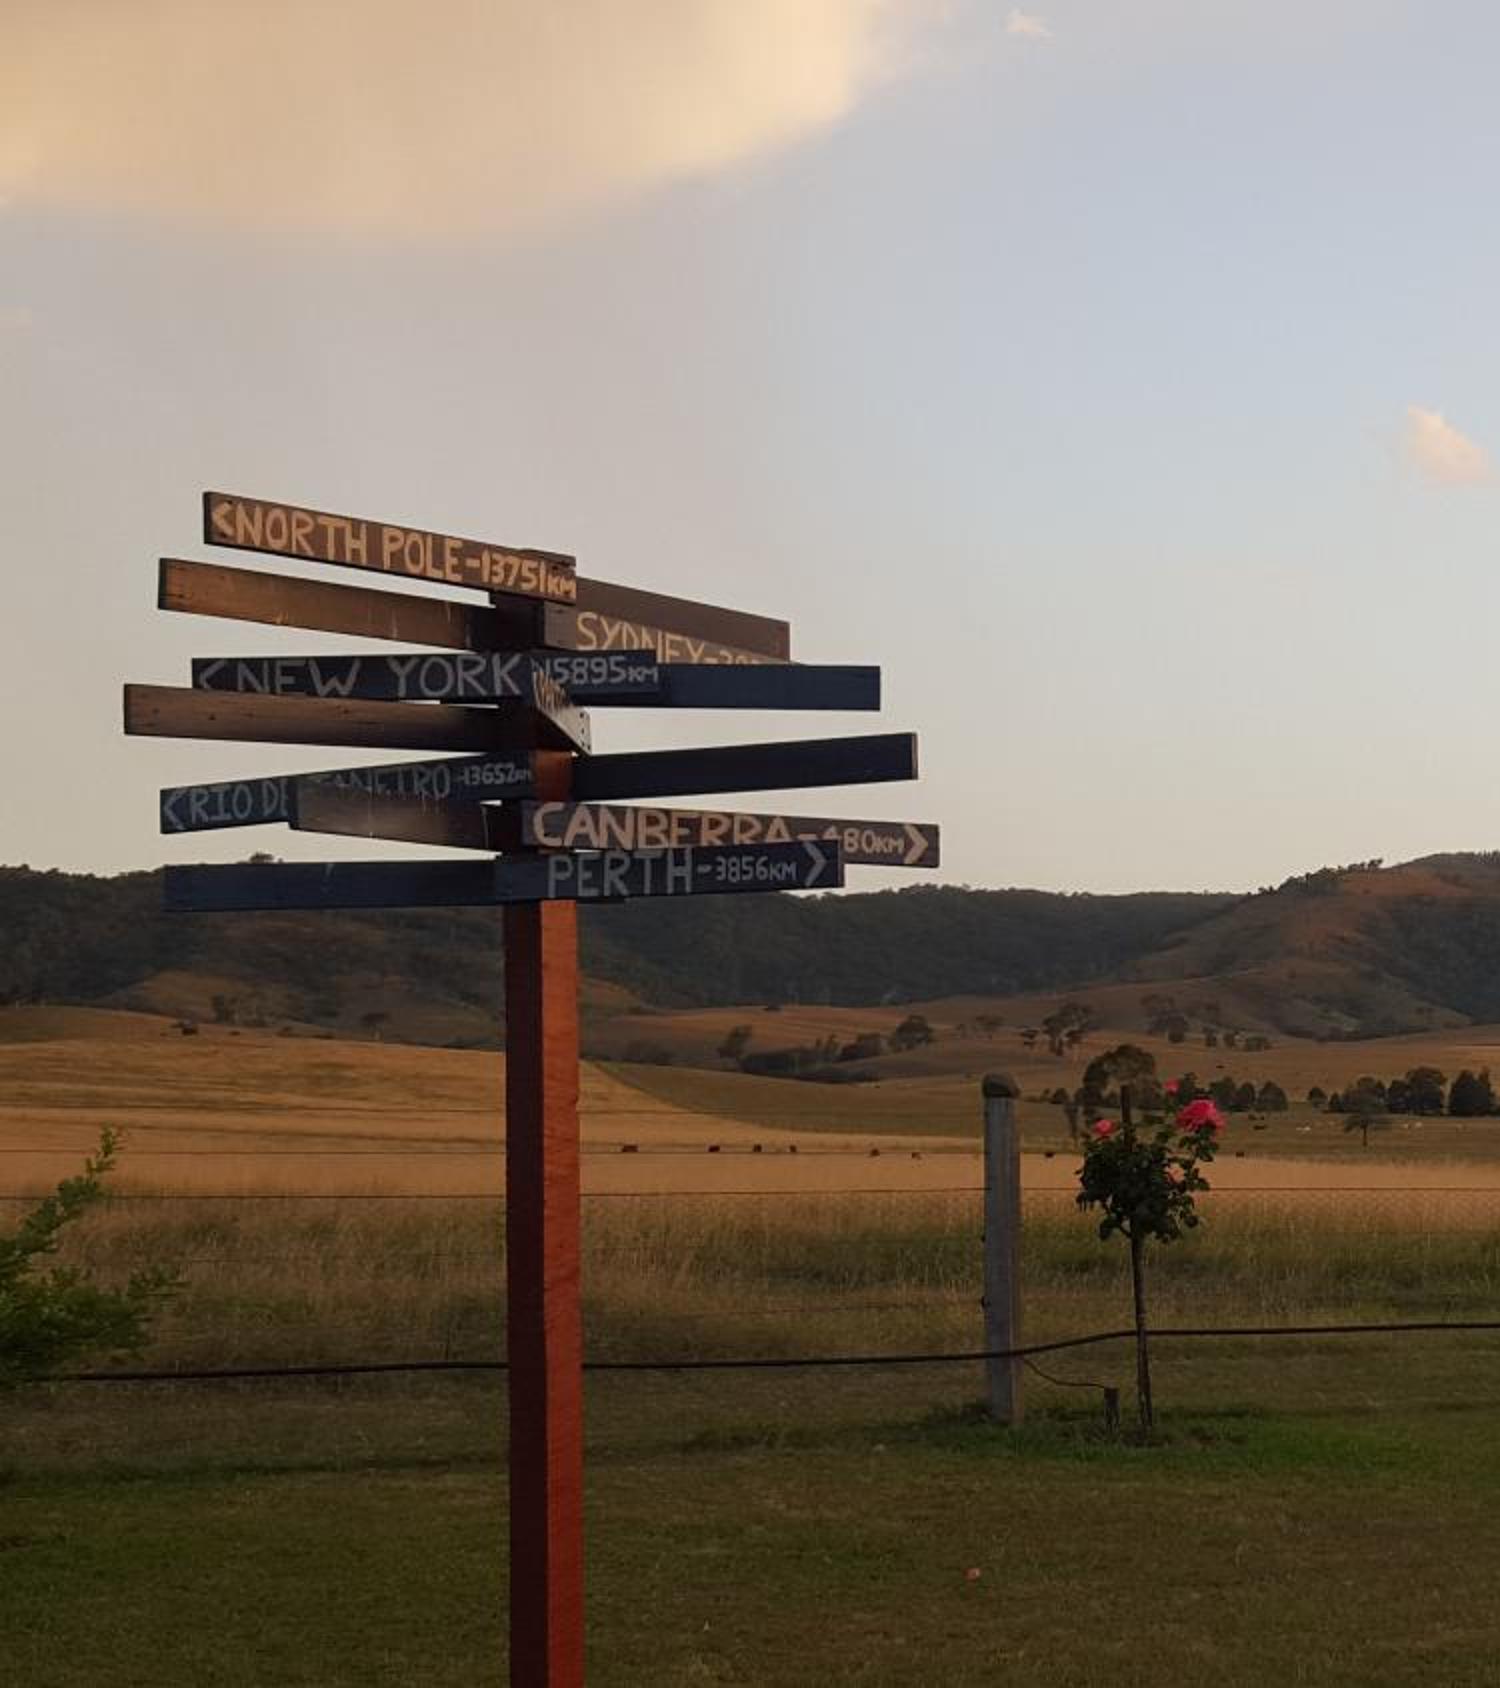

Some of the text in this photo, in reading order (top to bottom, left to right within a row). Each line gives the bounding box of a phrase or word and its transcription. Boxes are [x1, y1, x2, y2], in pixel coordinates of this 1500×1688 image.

[235, 502, 368, 566] NORTH
[236, 658, 362, 698] NEW
[386, 654, 522, 698] YORK
[190, 784, 253, 825] RIO
